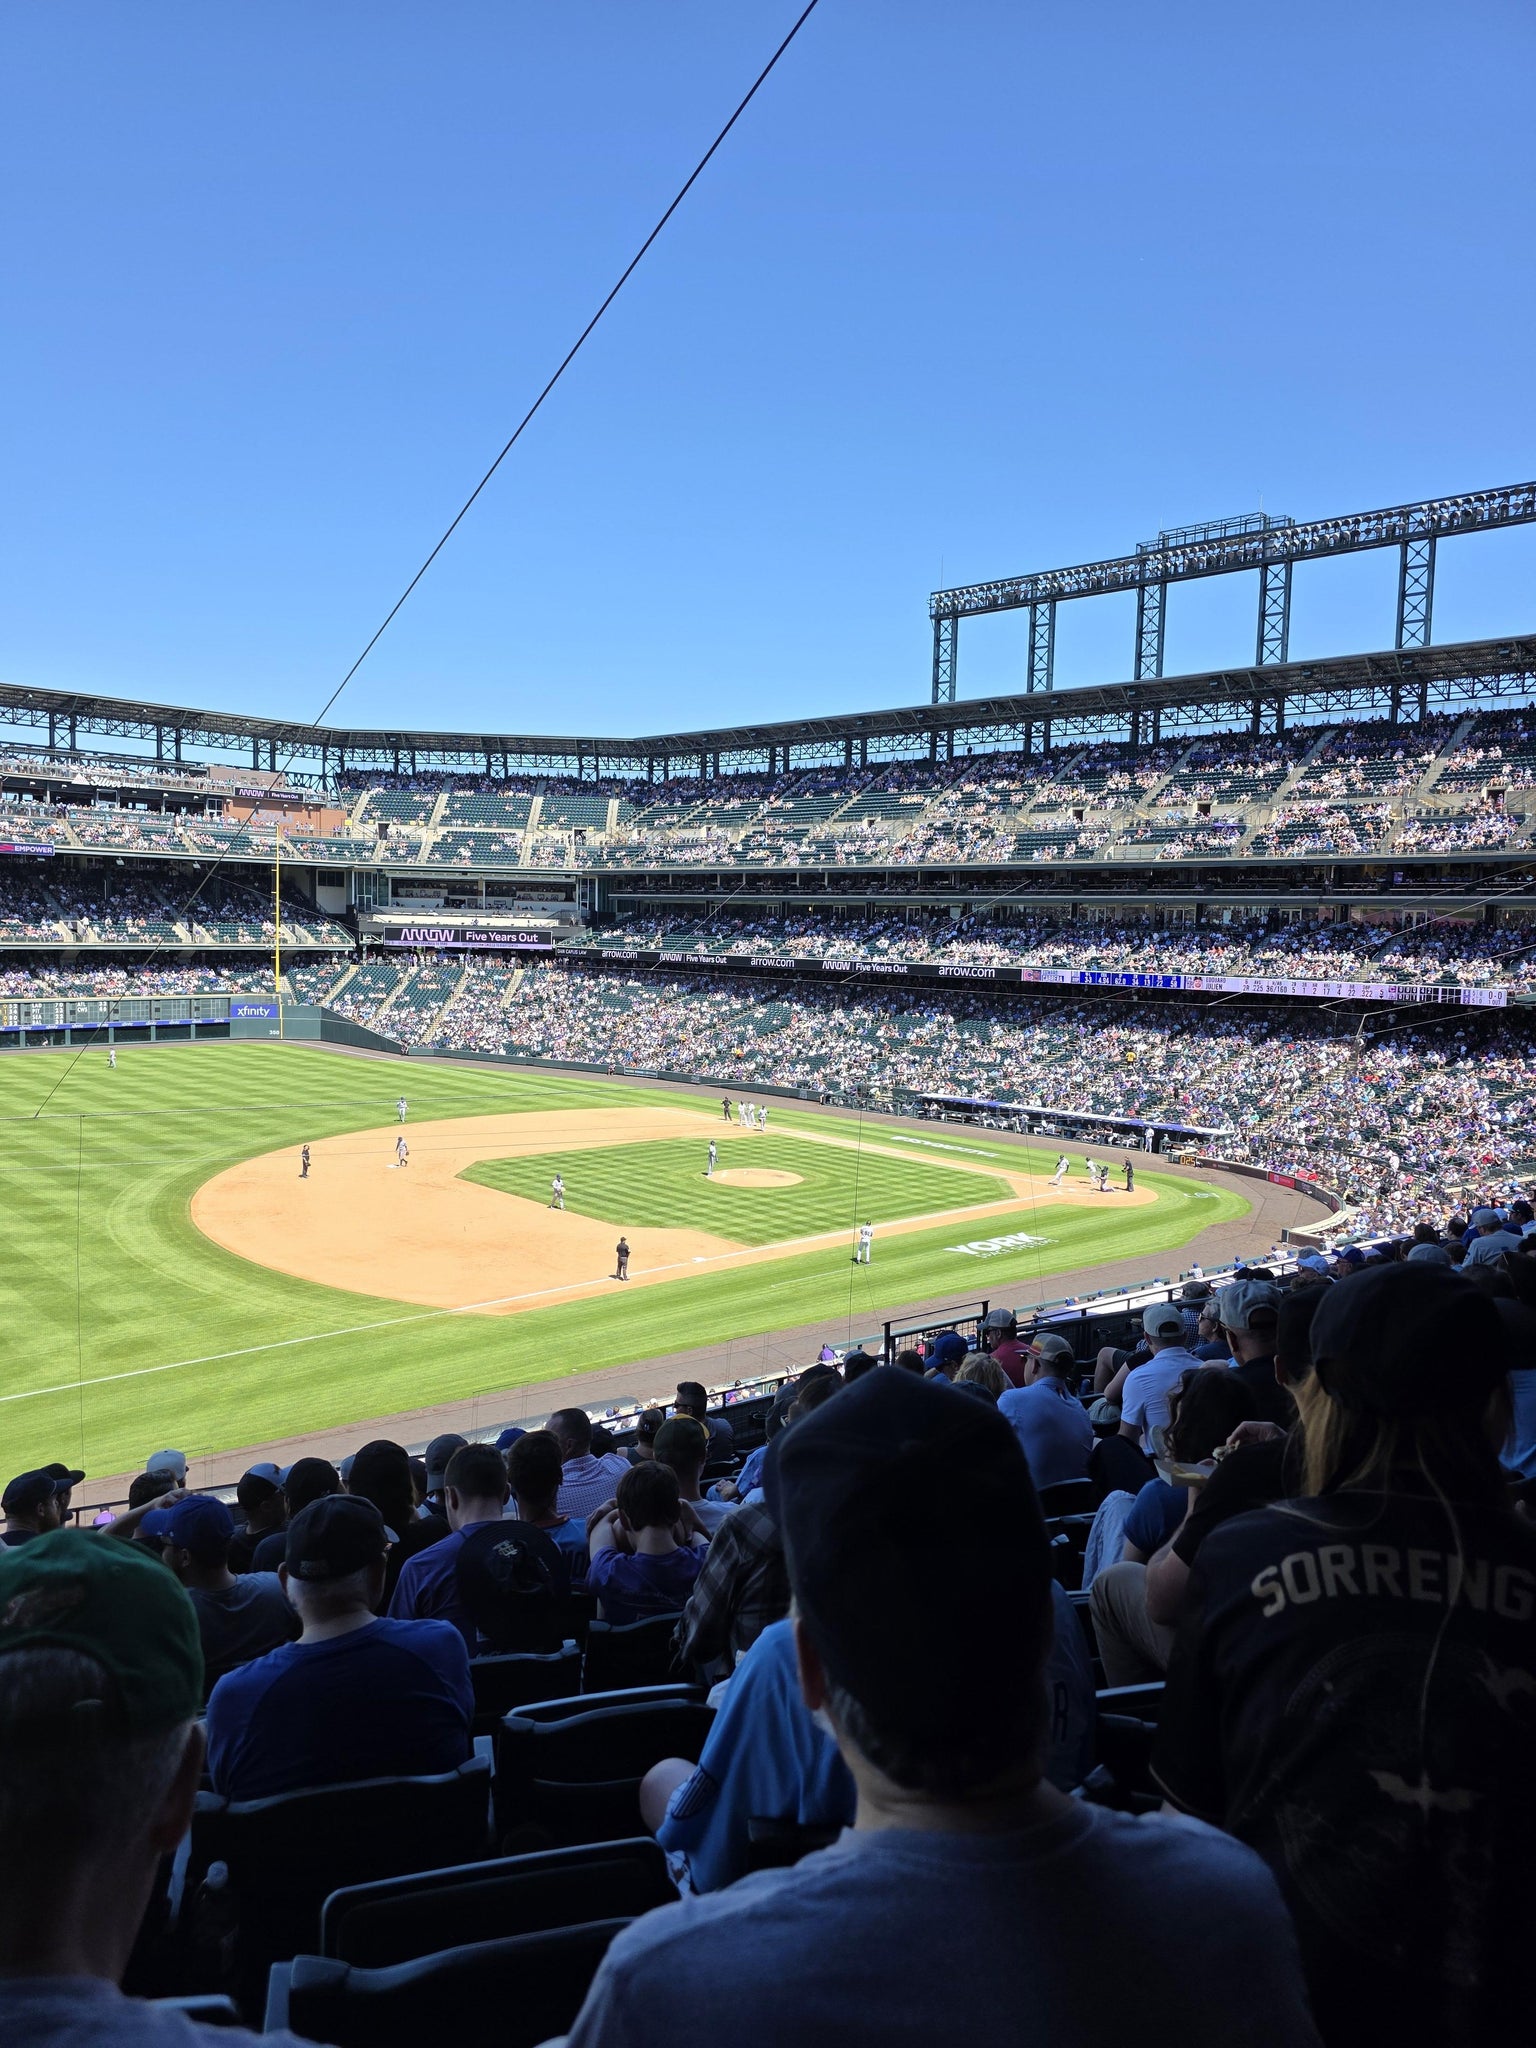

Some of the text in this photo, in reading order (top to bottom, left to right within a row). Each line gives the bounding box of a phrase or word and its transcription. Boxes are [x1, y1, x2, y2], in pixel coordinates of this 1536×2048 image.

[14, 845, 53, 854] EMPOWER
[400, 928, 538, 942] ARROW Five Years Out
[602, 950, 638, 959] arrow.com
[660, 952, 727, 964] ARROW Five Years Out
[750, 957, 794, 967] arrow.com
[822, 960, 908, 973] ARROW Five Years Out
[938, 966, 995, 978] arrow.com
[1488, 991, 1502, 1000] 0-0
[237, 1004, 270, 1017] xfinity
[1180, 1156, 1196, 1166] 025
[942, 1232, 1048, 1256] YORK
